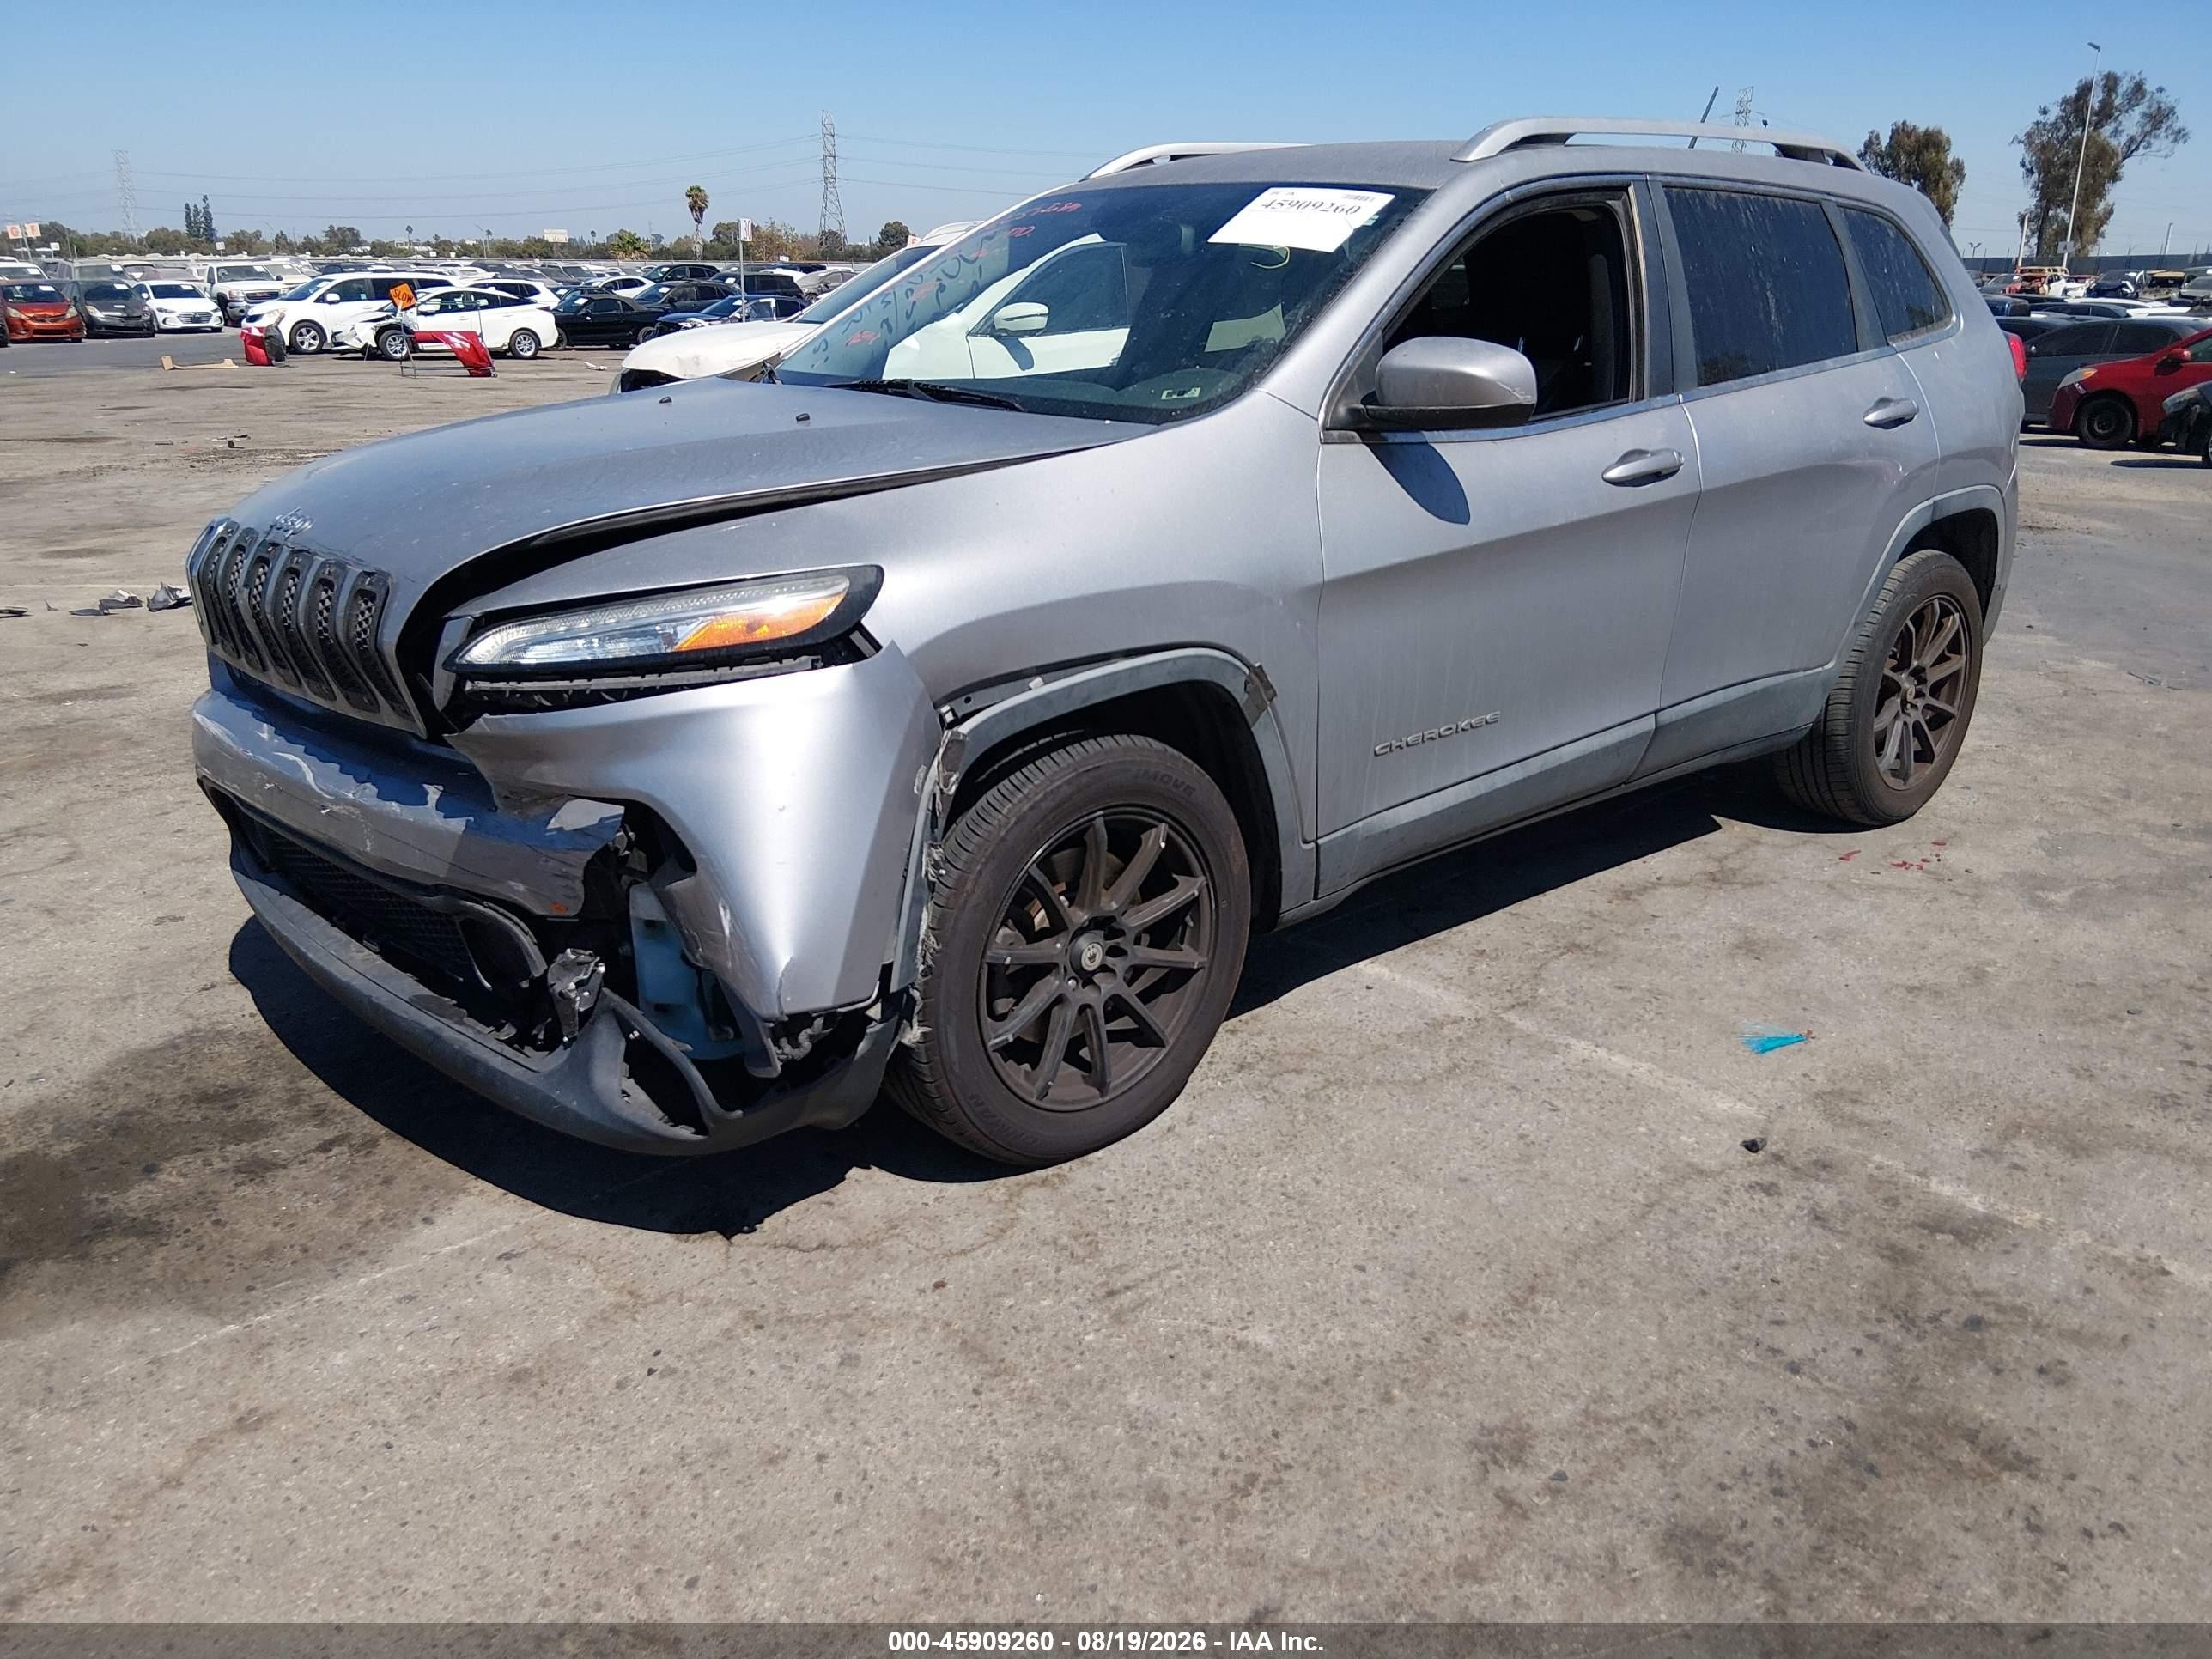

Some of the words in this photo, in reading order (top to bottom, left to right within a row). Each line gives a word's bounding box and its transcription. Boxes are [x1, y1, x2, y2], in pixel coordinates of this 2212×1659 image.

[1261, 198, 1361, 216] 45909260
[392, 288, 413, 304] SLOW
[1374, 710, 1501, 757] CHEROKEE
